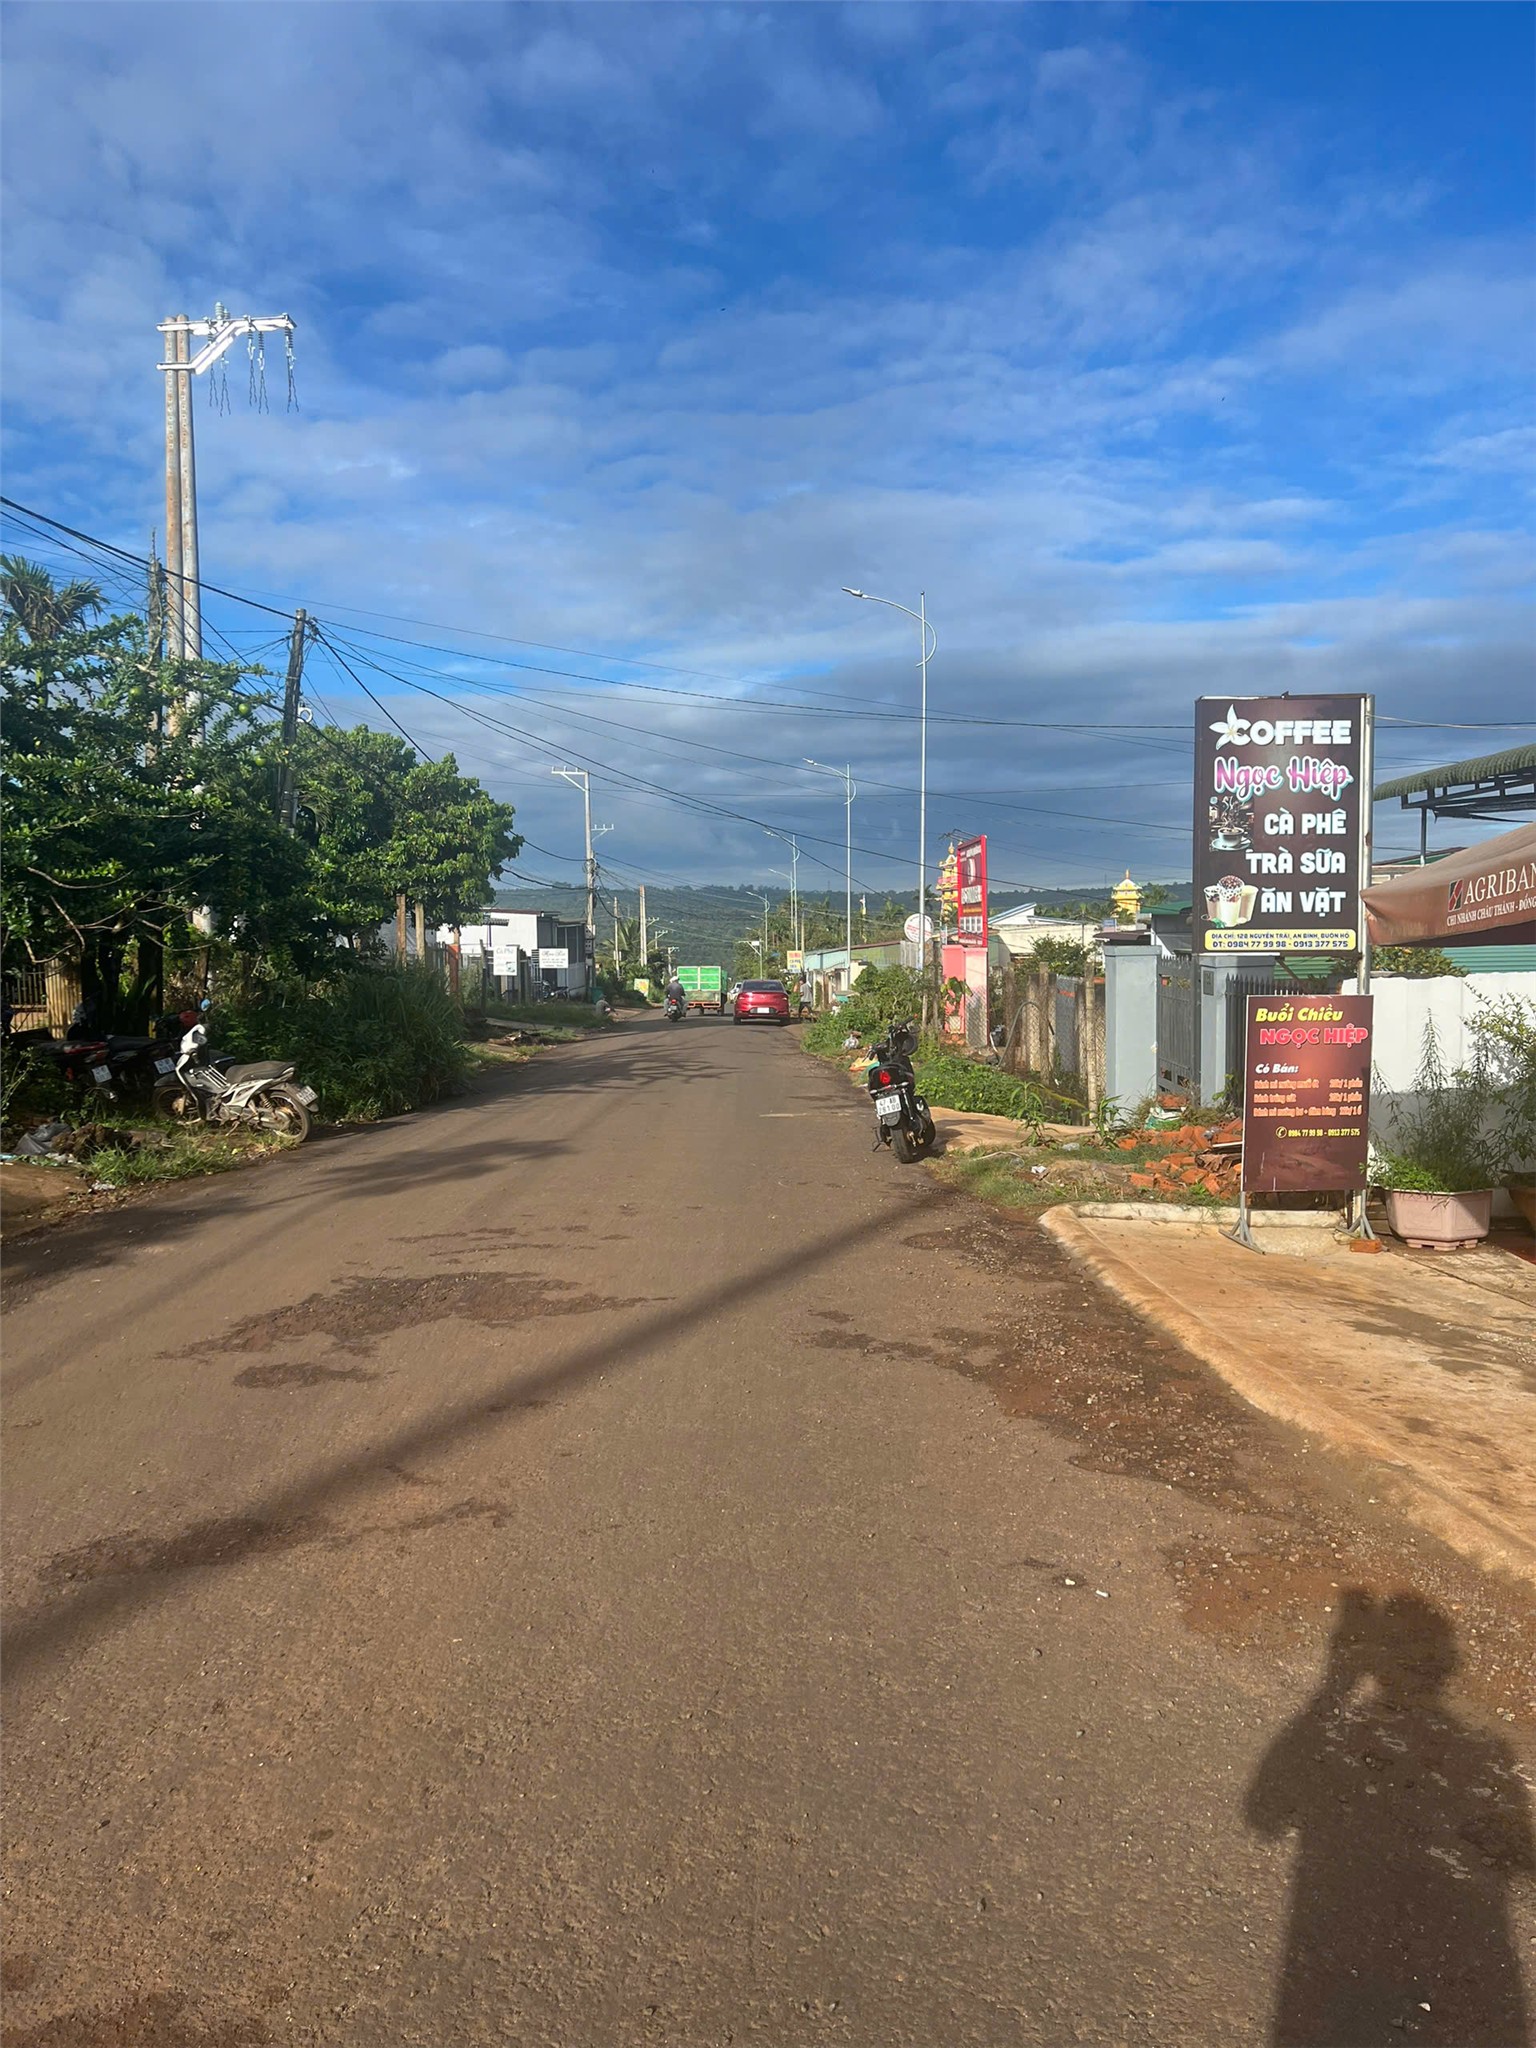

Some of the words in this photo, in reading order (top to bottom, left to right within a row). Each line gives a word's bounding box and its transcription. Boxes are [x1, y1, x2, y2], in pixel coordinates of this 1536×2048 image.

[1231, 720, 1351, 746] COFFEE
[1215, 757, 1282, 800] Ngọc
[1287, 757, 1354, 800] Hiệp
[1264, 808, 1294, 834] CÀ
[1302, 808, 1347, 834] PHÊ
[1246, 847, 1293, 874] TRÀ
[1300, 848, 1346, 874] SỮA
[1261, 887, 1293, 912] ĂN
[1300, 887, 1346, 916] VẶT
[1293, 940, 1313, 948] 0913
[1315, 940, 1330, 948] 377
[1332, 940, 1348, 948] 575
[1255, 1003, 1294, 1022] Buổi
[1297, 1003, 1344, 1022] Chiều
[1260, 1028, 1320, 1049] NGỌC
[1324, 1023, 1369, 1049] HIỆP
[1255, 1063, 1271, 1074] Có
